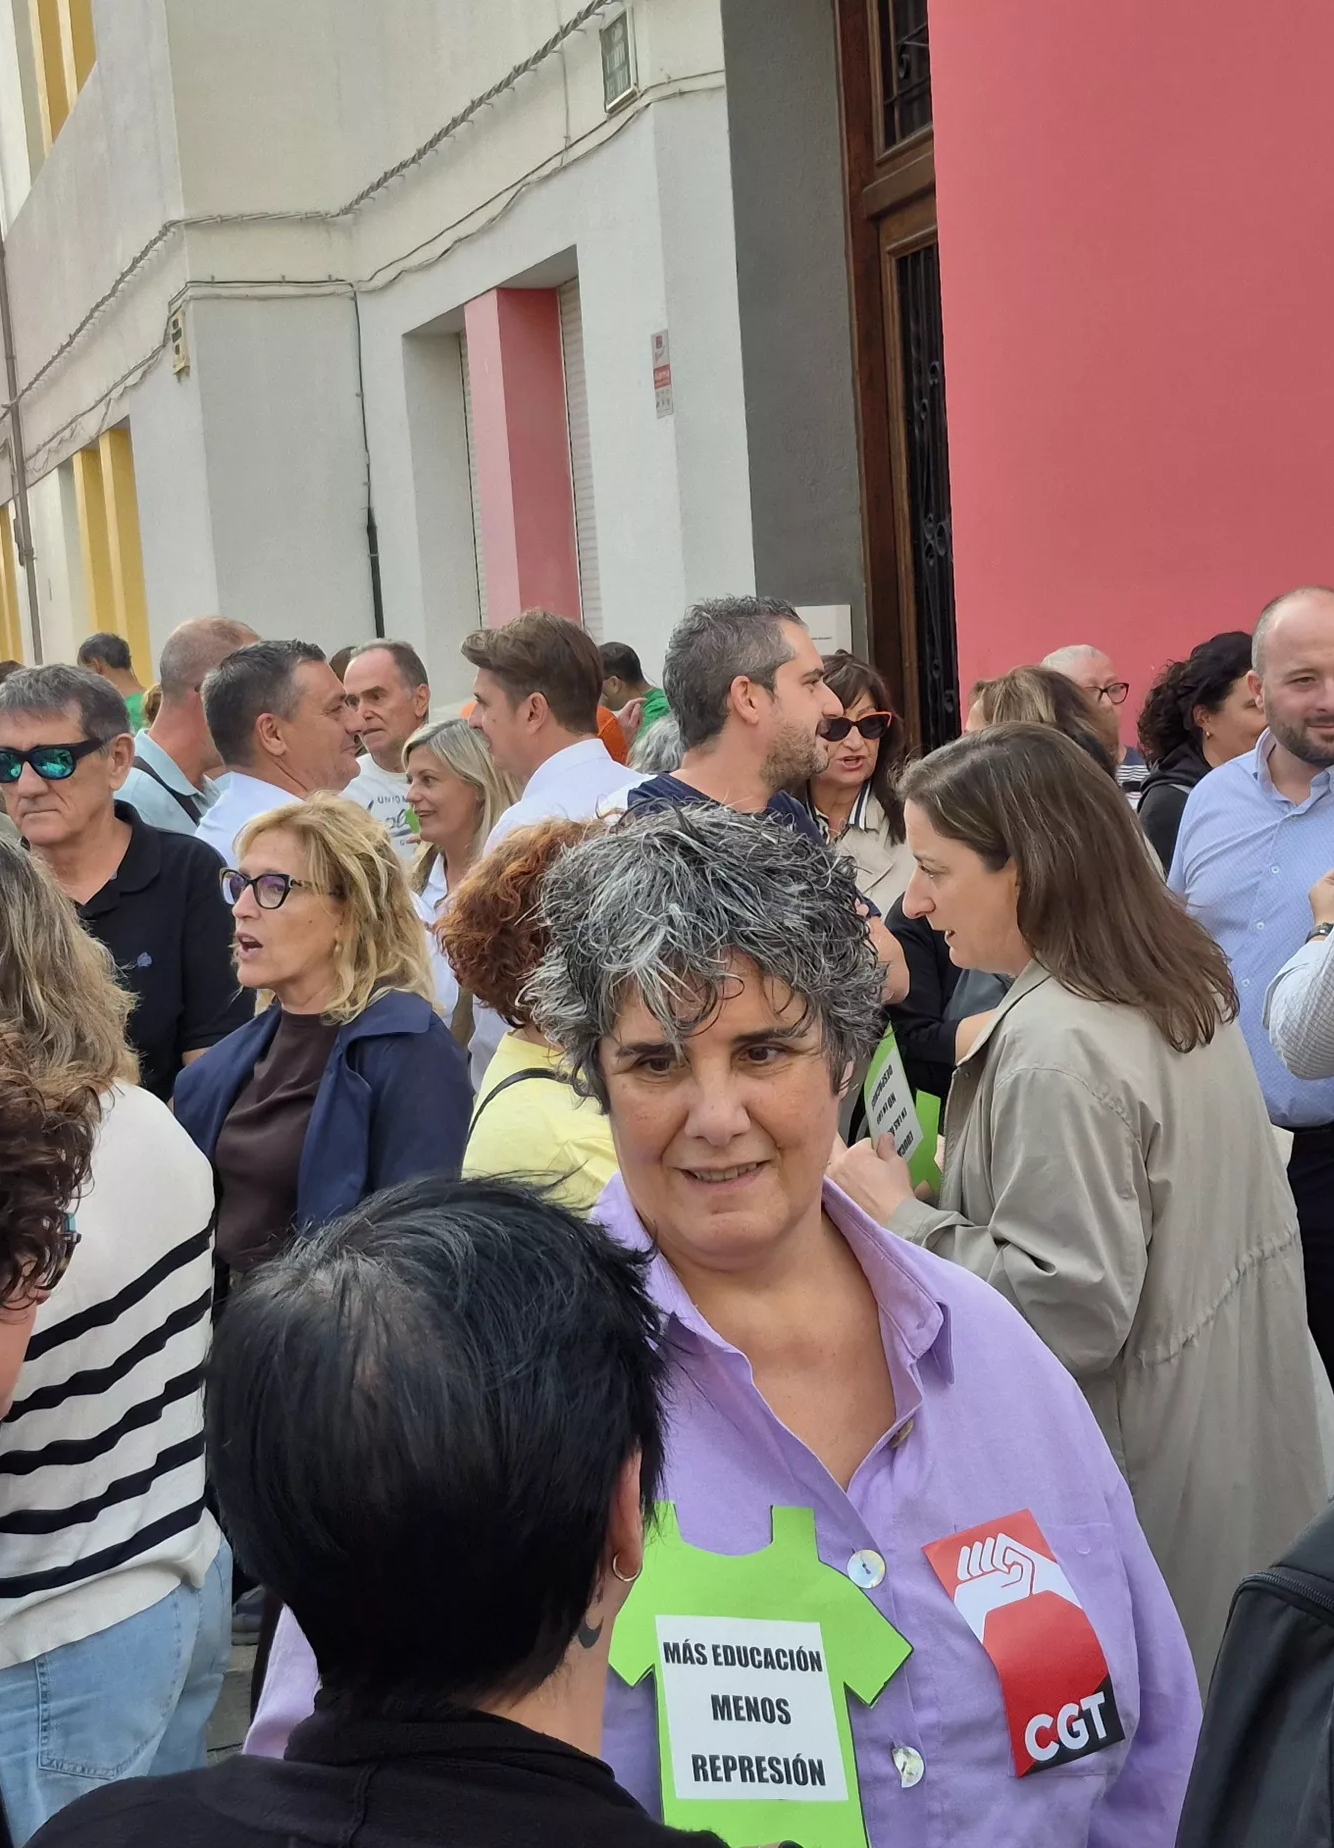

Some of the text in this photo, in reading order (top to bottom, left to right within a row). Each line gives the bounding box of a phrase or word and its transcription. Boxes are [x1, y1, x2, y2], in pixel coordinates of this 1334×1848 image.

[663, 1639, 823, 1672] MÁS EDUCACIÓN
[710, 1694, 792, 1725] MENOS
[1024, 1691, 1107, 1762] CGT
[691, 1753, 826, 1787] REPRESIÓN
